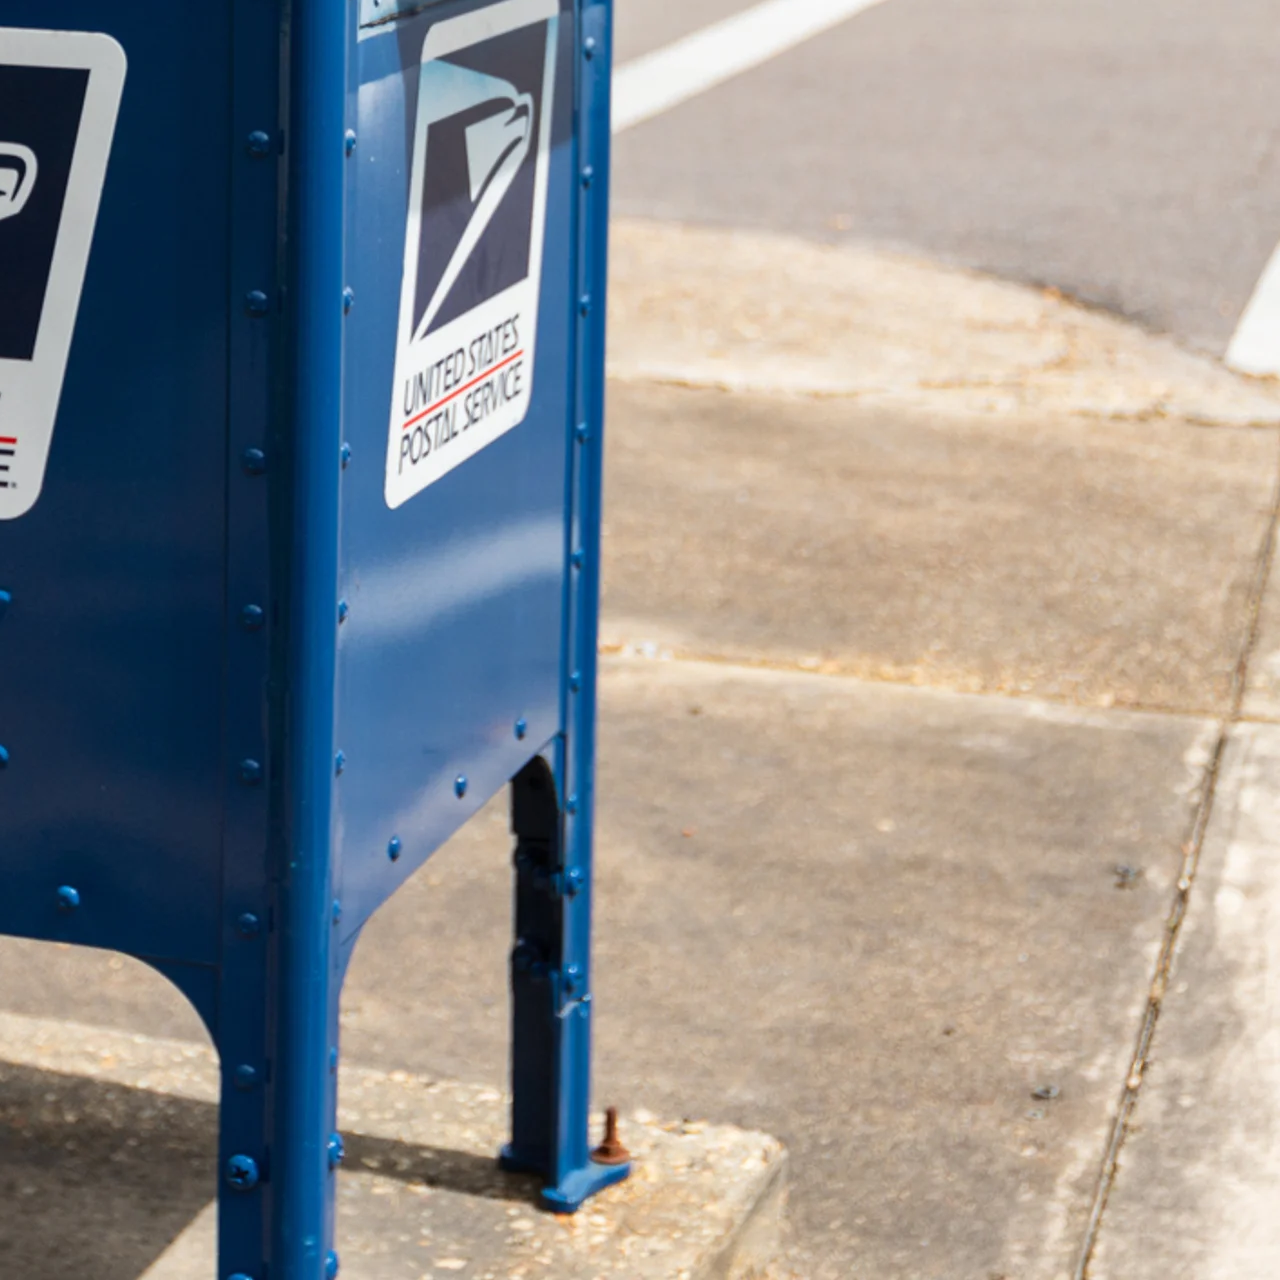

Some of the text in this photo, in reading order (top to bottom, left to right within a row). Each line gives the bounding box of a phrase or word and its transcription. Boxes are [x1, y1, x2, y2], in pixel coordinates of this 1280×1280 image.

[398, 360, 523, 475] POSTAL SERVICE
[404, 313, 520, 417] UNITED STATES
